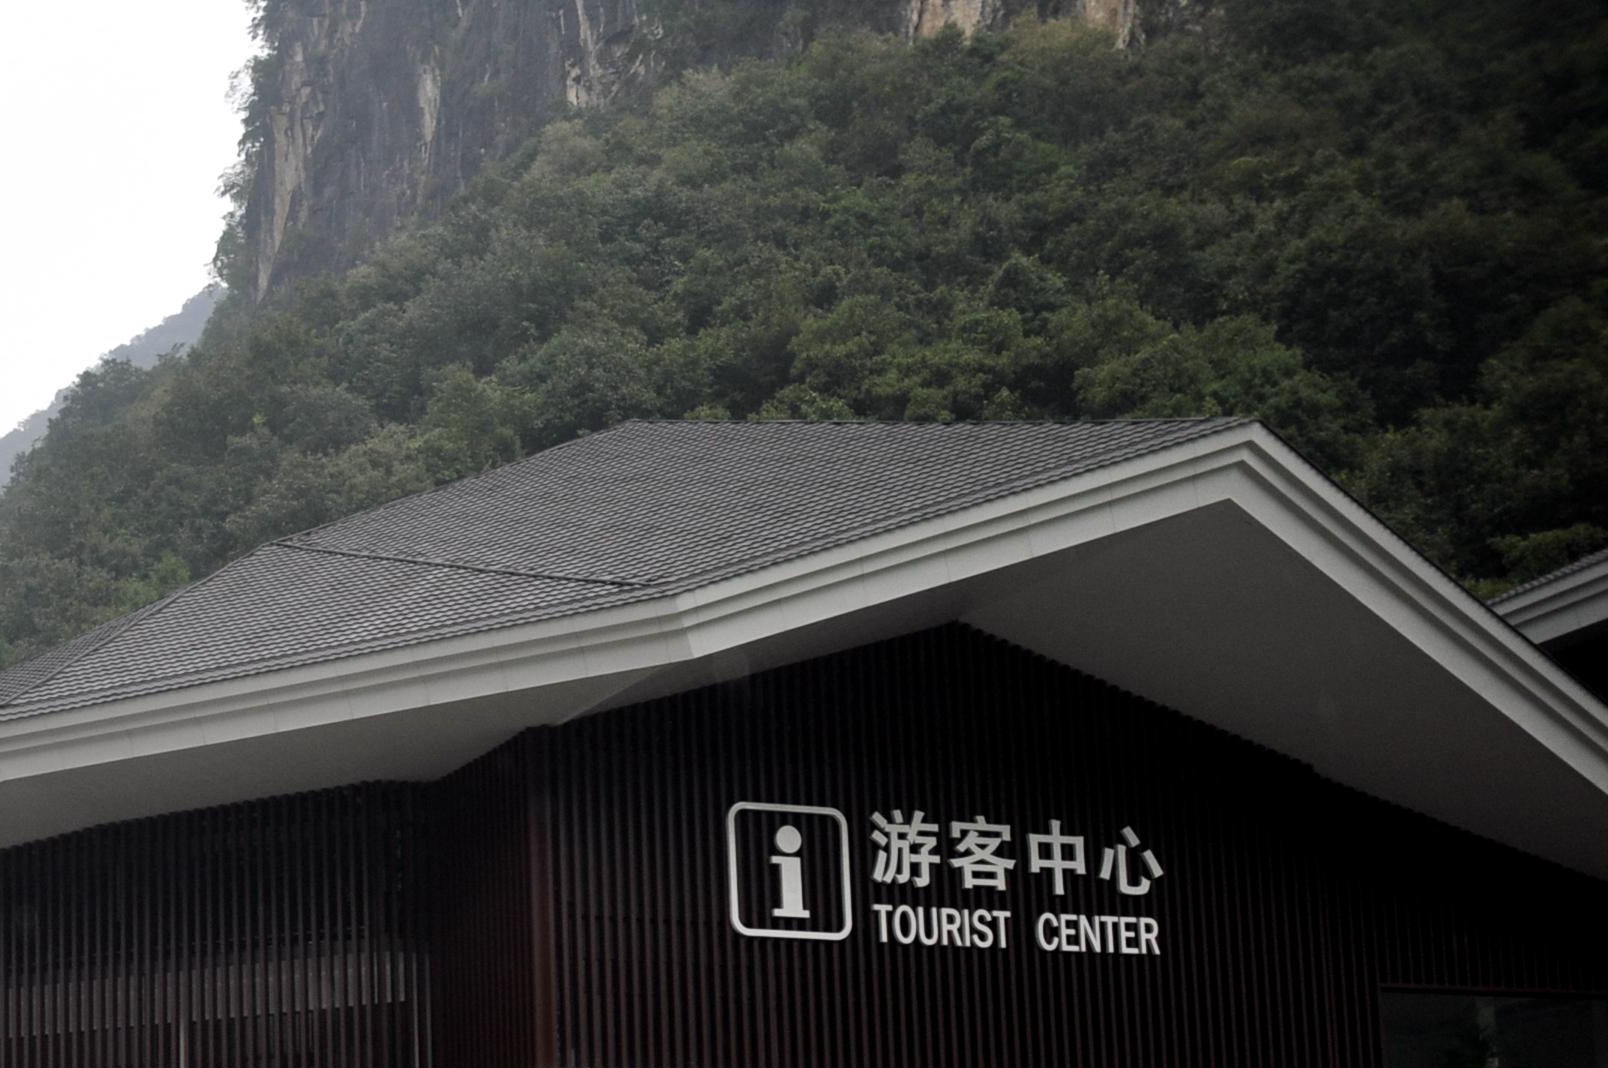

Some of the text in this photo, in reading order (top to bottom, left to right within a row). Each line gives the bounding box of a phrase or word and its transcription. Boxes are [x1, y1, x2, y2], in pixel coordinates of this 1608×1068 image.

[870, 809, 1164, 897] 游客中心
[872, 903, 1162, 956] TOURIST CENTER
